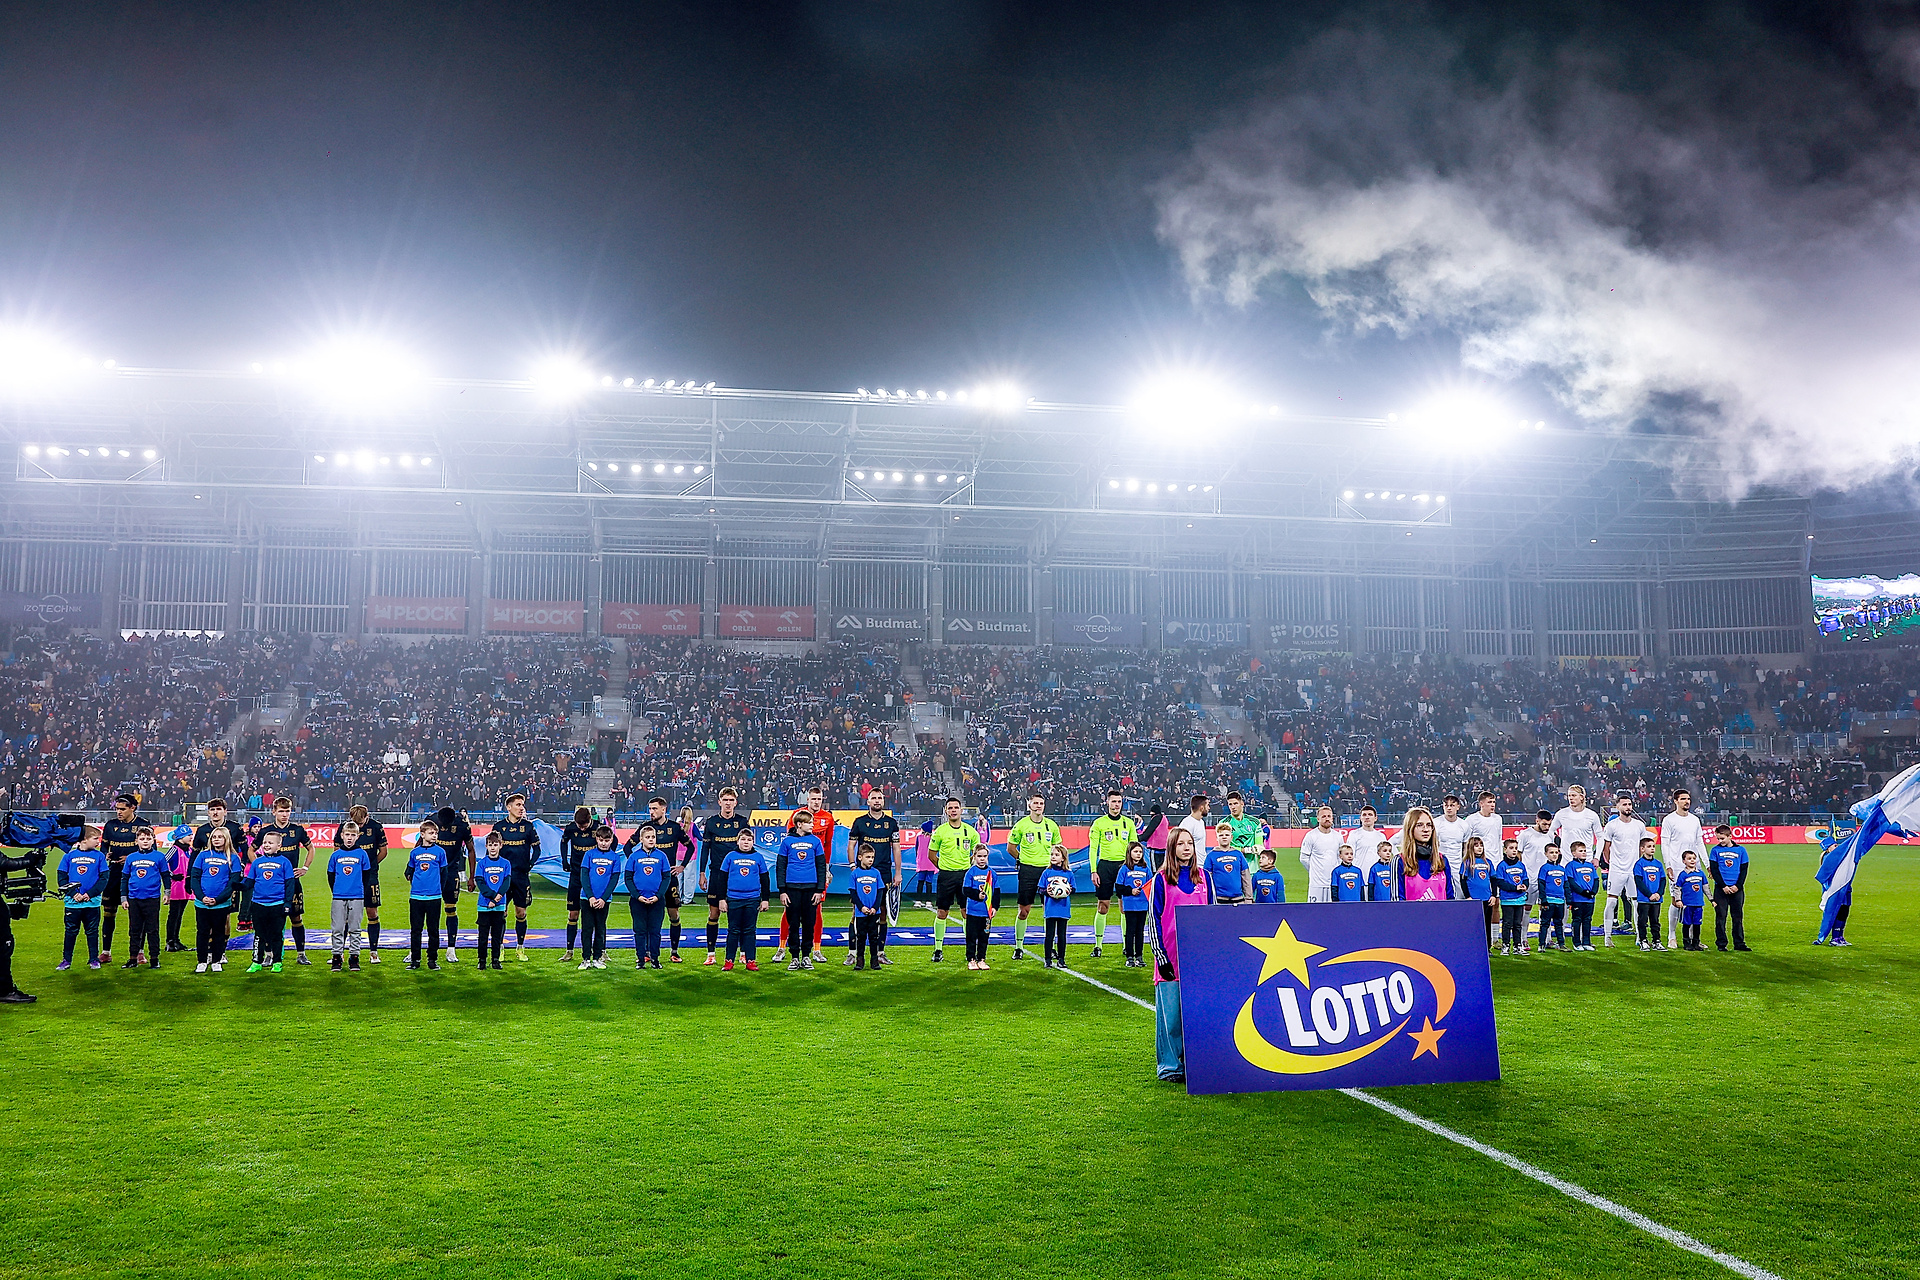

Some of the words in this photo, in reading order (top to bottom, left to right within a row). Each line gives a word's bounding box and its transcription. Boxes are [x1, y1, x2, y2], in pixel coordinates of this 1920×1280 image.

[23, 604, 81, 613] IZOTECHNIK
[394, 605, 457, 621] PŁOCK
[512, 609, 575, 625] PŁOCK
[866, 617, 922, 629] Budmat.
[977, 621, 1031, 632] Budmat.
[1073, 624, 1122, 633] IZOTECHNIK
[1292, 625, 1339, 638] POKIS
[1732, 827, 1766, 837] OKIS
[370, 885, 380, 897] 15
[1276, 970, 1415, 1047] LOTTO
